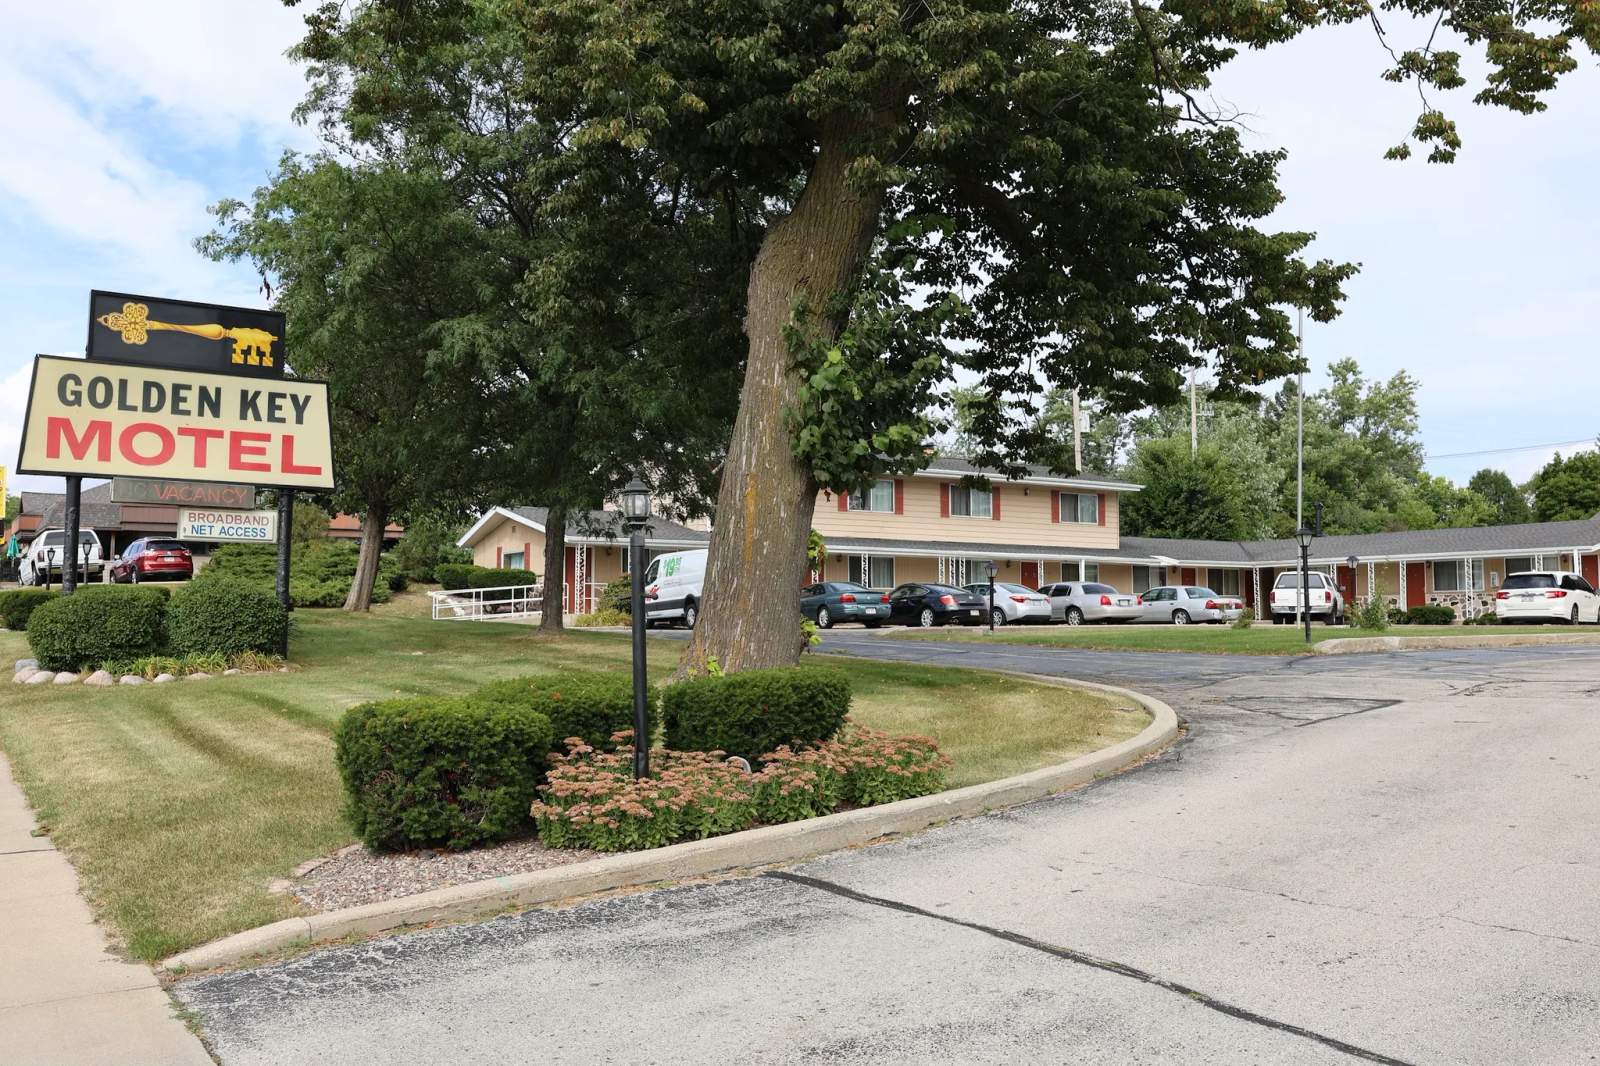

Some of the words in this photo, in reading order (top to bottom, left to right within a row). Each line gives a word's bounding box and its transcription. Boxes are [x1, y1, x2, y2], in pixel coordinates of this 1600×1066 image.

[57, 373, 221, 419] GOLDEN
[239, 388, 312, 425] KEY
[46, 416, 322, 476] MOTEL
[154, 484, 248, 505] VACANCY
[188, 512, 269, 526] BROADBAND
[191, 524, 214, 535] NET
[219, 526, 266, 537] ACCESS
